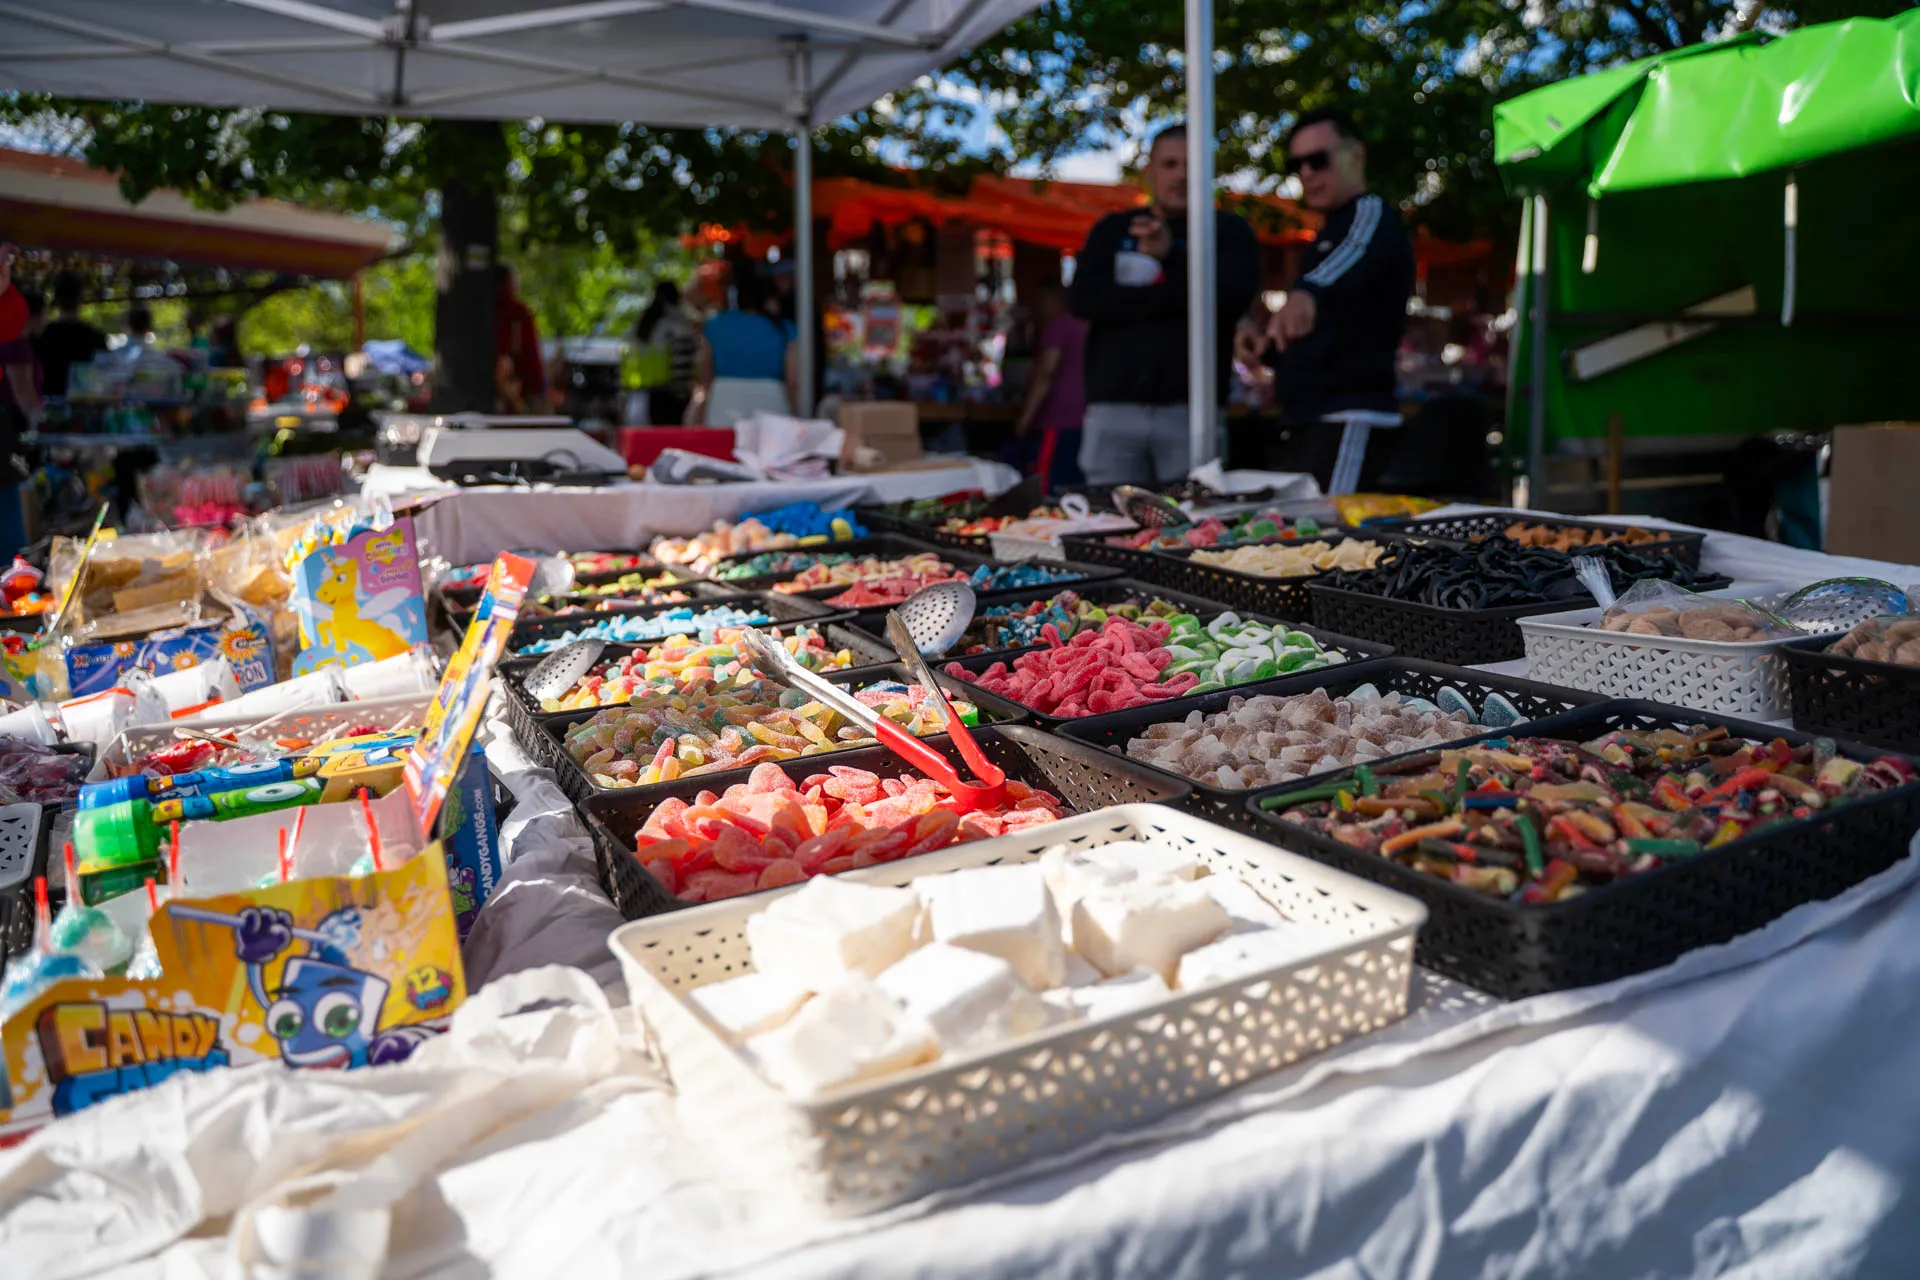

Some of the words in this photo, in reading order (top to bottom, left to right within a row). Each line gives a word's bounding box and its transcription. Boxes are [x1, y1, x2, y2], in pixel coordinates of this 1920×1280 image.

[472, 788, 495, 899] CANDYGANGS.COM
[407, 966, 441, 993] 12
[37, 1001, 220, 1082] CANDY
